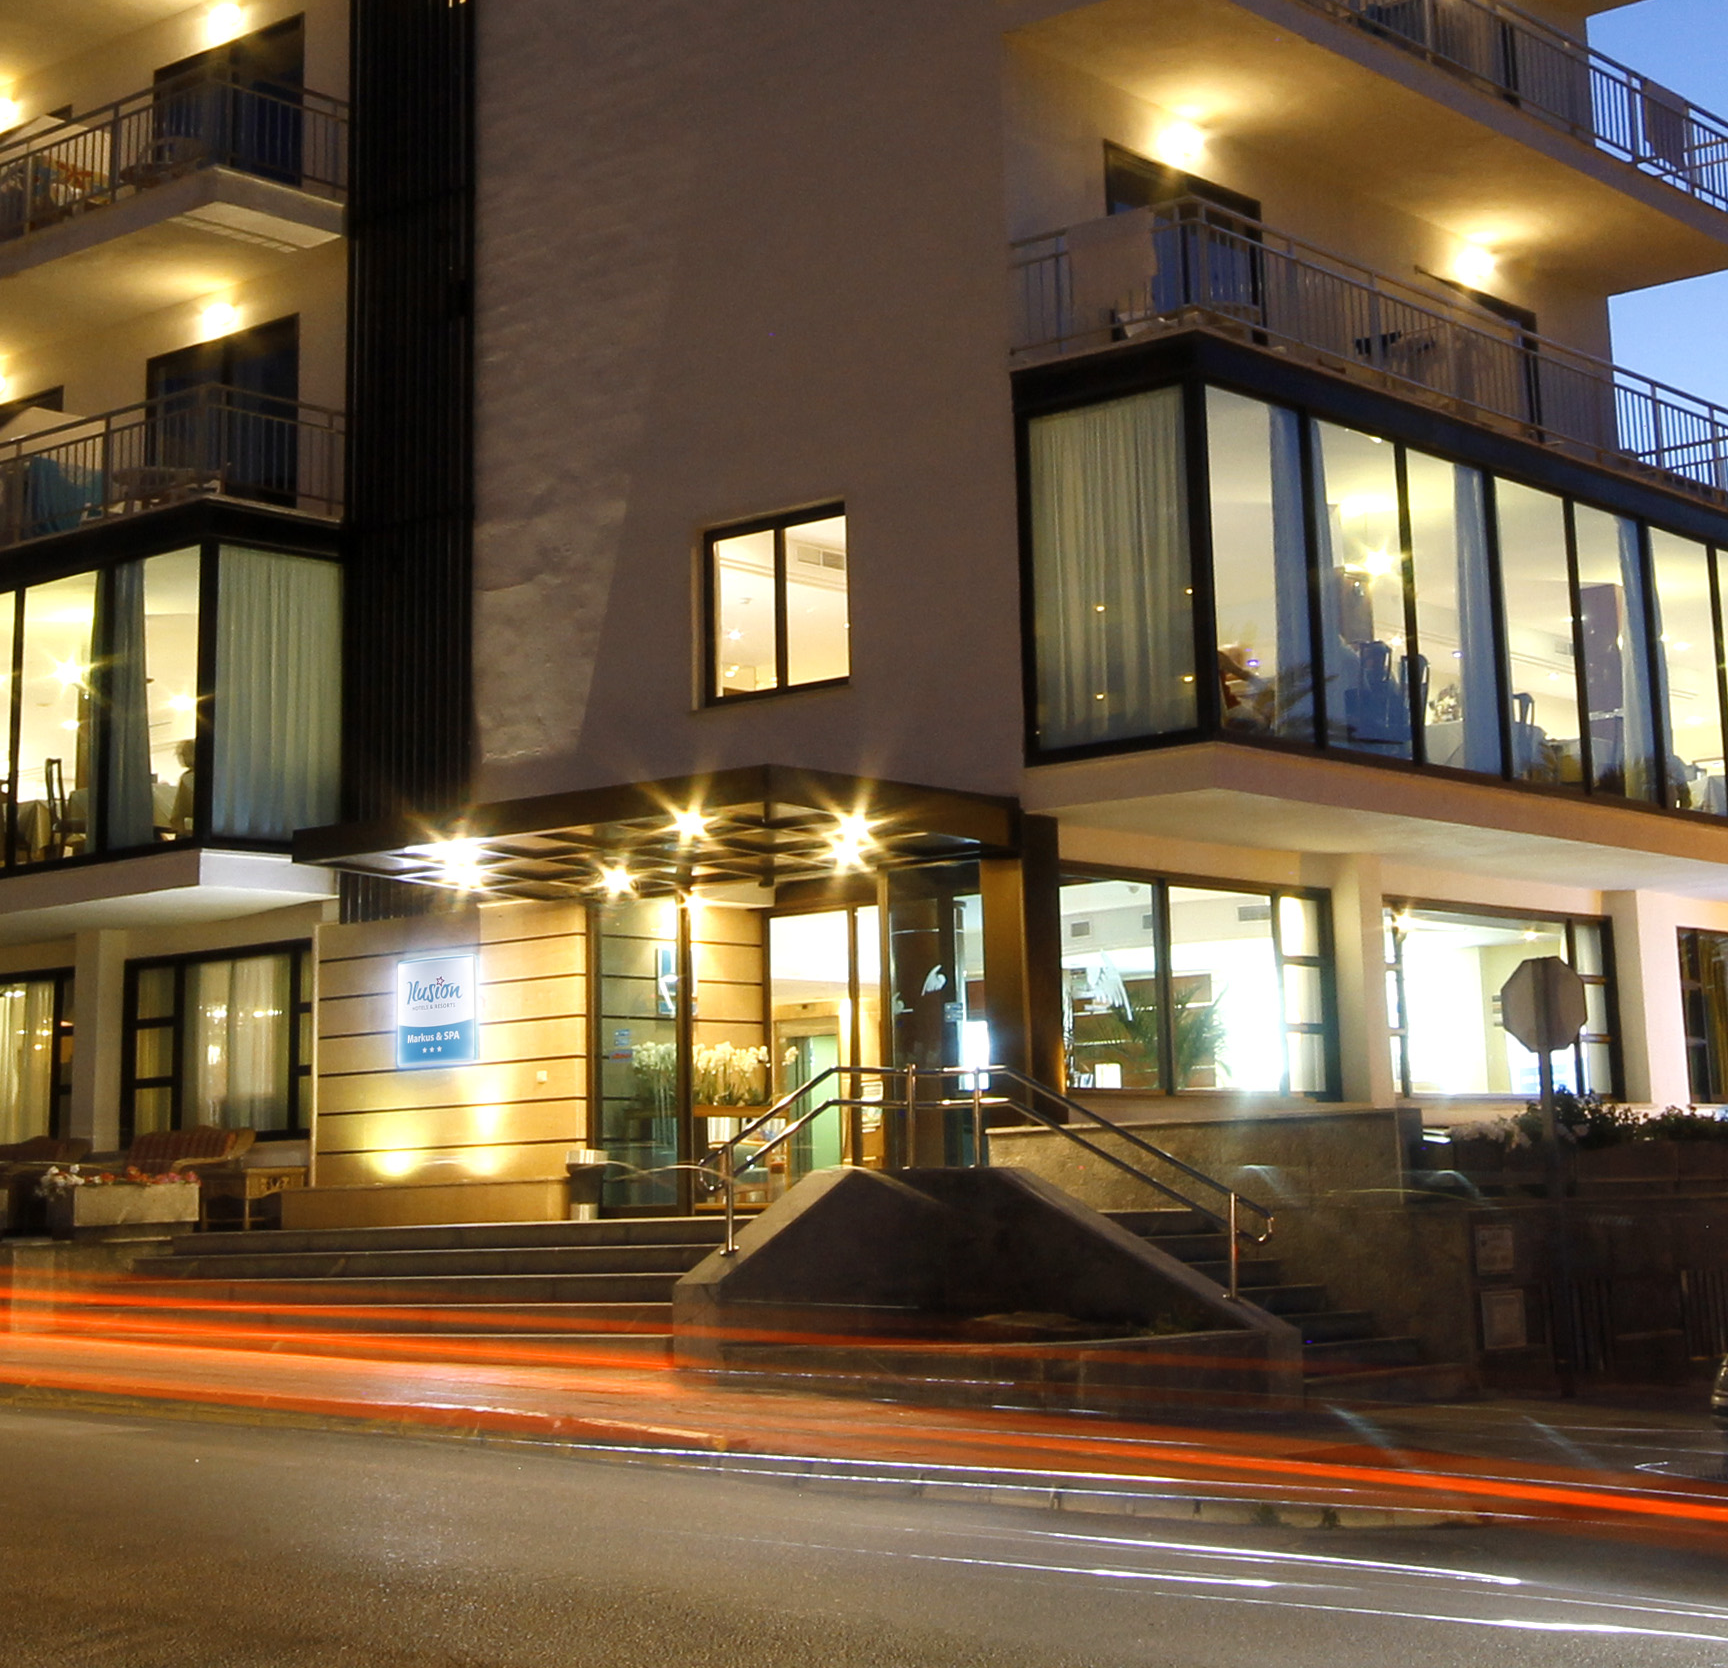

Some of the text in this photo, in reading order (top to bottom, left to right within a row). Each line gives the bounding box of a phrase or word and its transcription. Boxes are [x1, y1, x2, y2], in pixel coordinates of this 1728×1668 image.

[407, 977, 462, 1004] Ilusion
[407, 1030, 461, 1044] Markus & SPA
